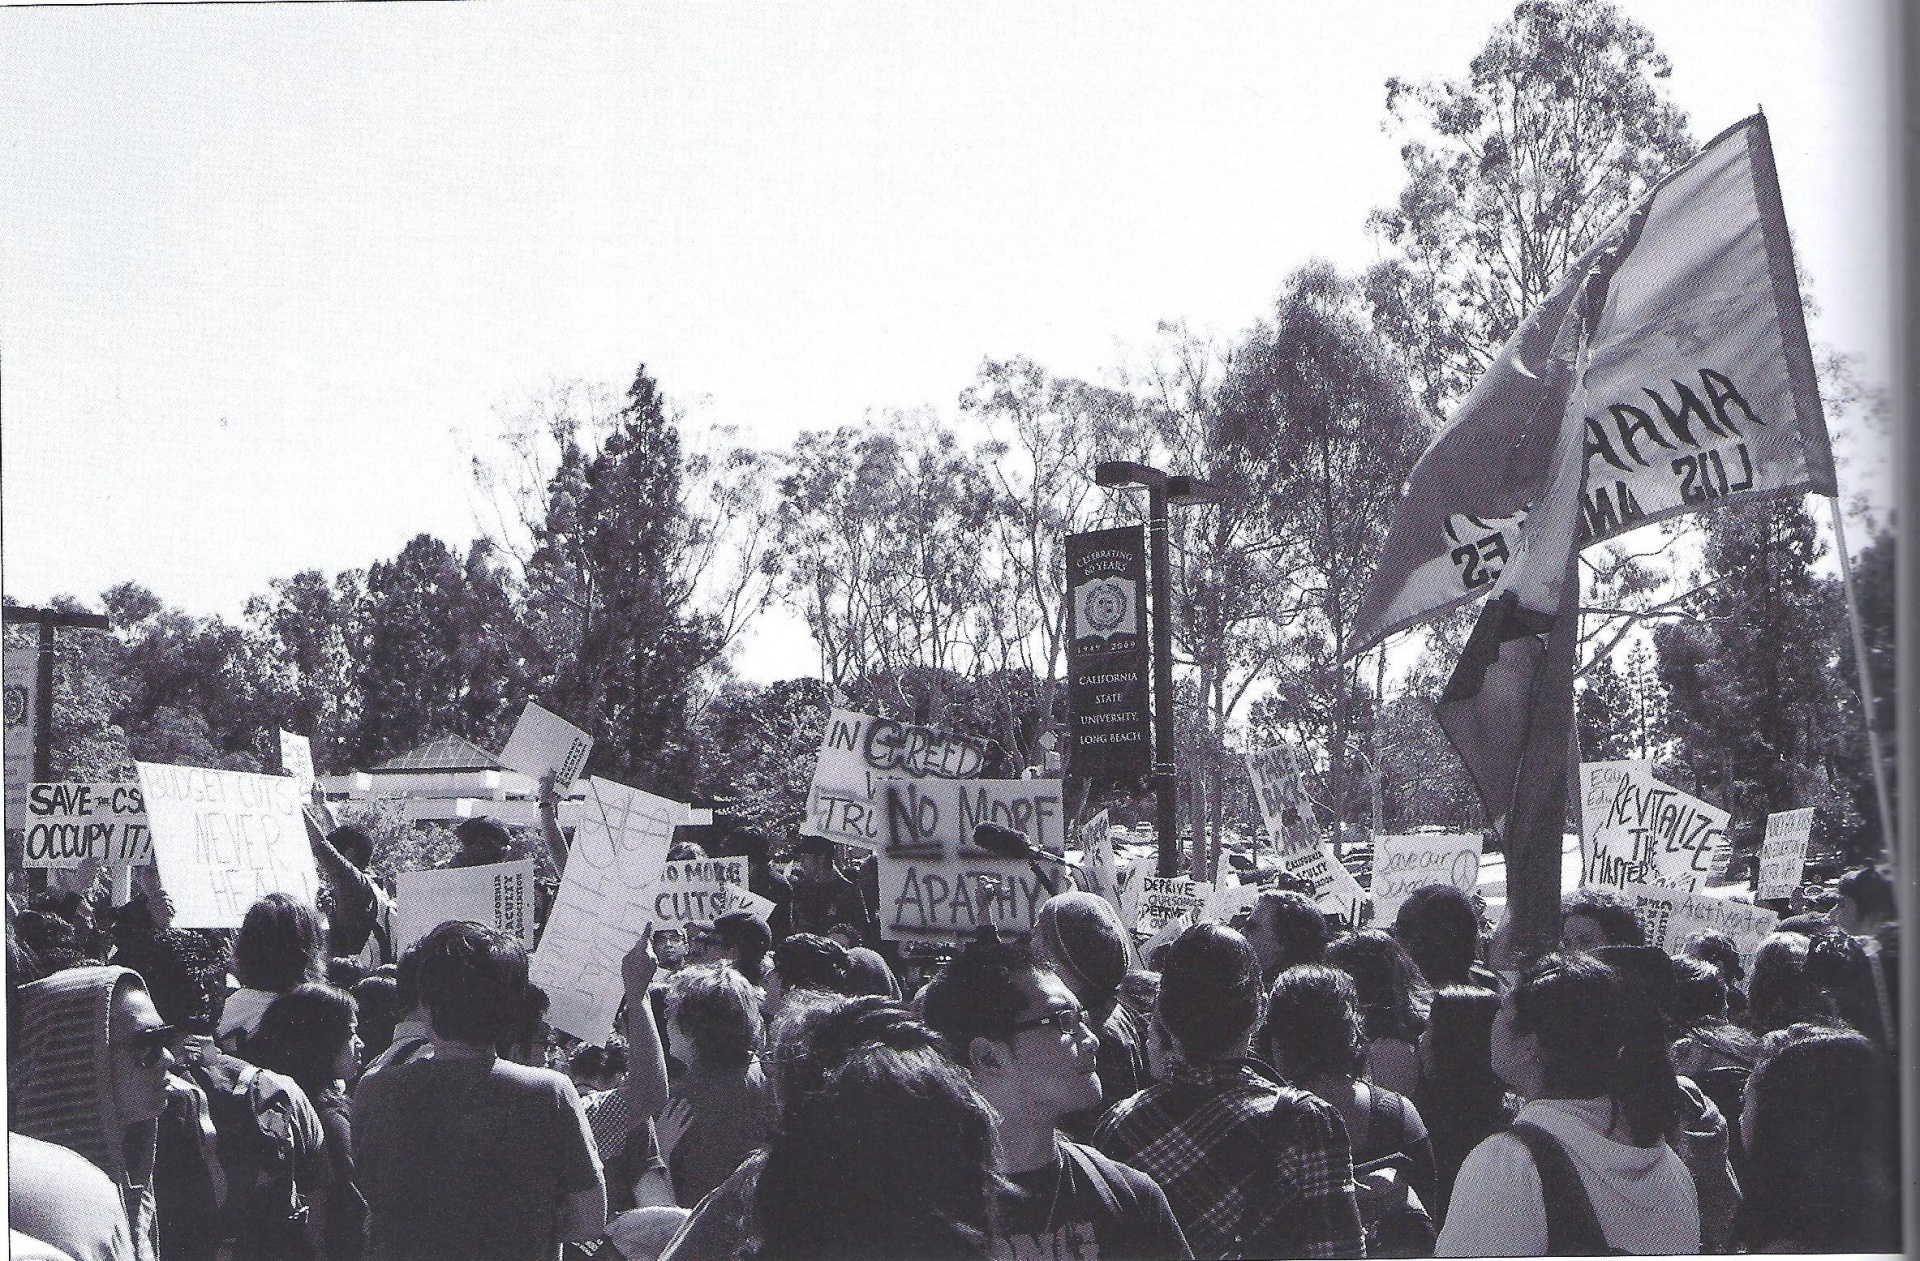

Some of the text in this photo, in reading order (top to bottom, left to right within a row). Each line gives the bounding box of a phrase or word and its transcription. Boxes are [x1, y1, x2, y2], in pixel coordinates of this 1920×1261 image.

[1076, 549, 1133, 568] CELEBRATING
[1096, 560, 1127, 573] YEARS
[1079, 672, 1138, 686] CALIFORNIA
[1095, 692, 1122, 704] STATE
[828, 717, 985, 780] IN GREED
[1080, 731, 1141, 746] LONG BEACH
[29, 784, 92, 815] SAVE
[884, 783, 939, 846] NO
[1605, 771, 1723, 872] REVITALIZE
[26, 822, 153, 860] OCCUPY IT!
[195, 811, 288, 871] NEVER
[661, 864, 679, 883] O
[896, 866, 1042, 928] APATHY
[1143, 877, 1196, 897] DEPRIVE
